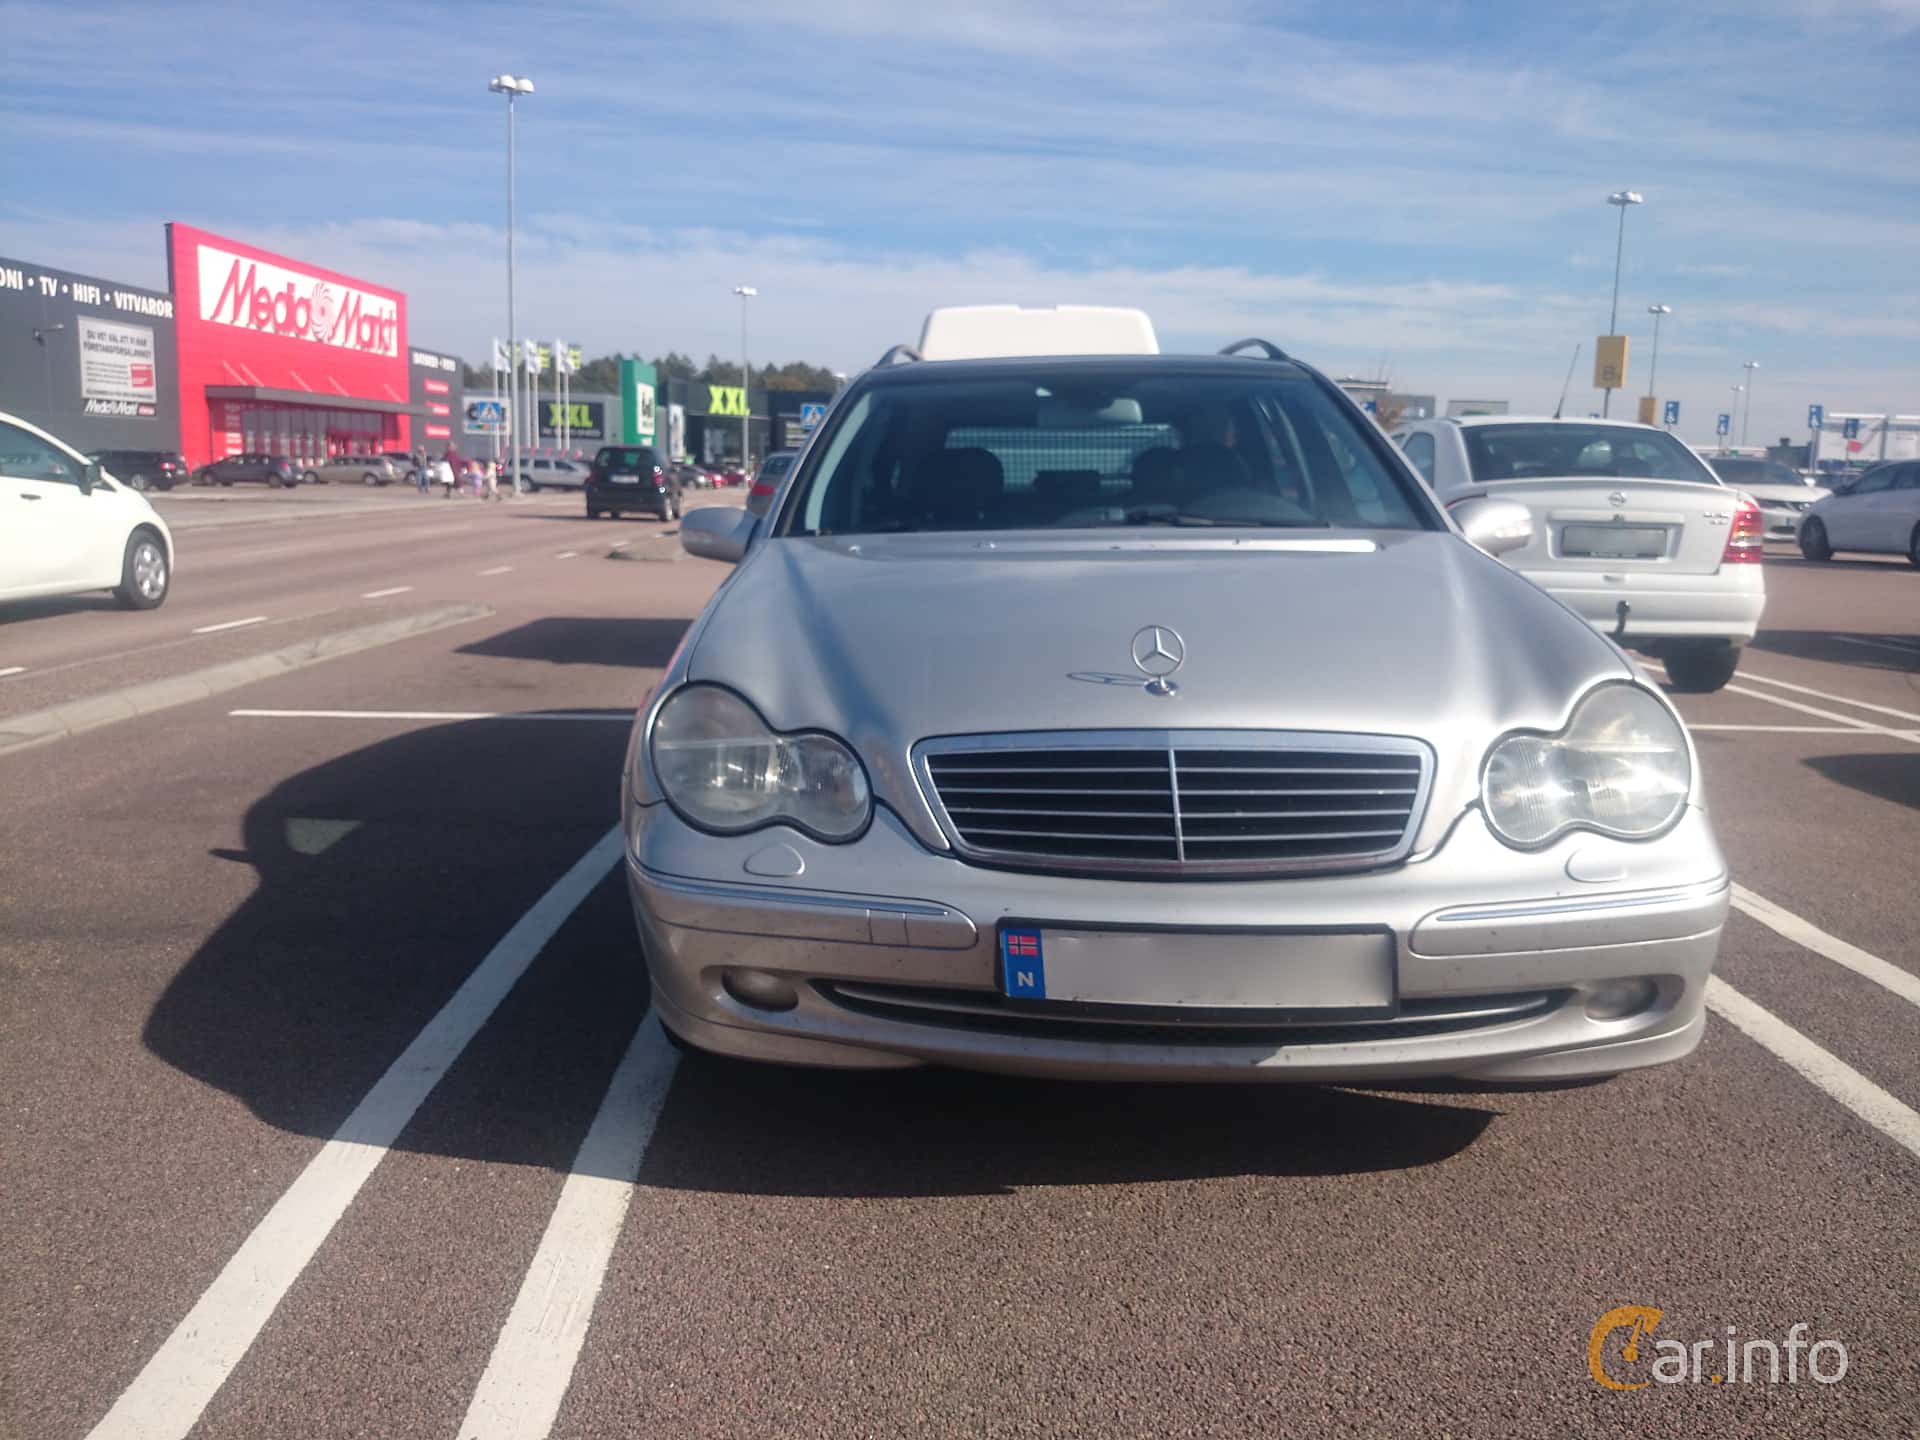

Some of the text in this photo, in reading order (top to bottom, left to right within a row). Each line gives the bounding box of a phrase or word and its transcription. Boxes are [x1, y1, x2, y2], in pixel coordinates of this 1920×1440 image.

[39, 276, 58, 297] TV
[73, 283, 101, 306] HIFI
[113, 290, 173, 319] VITVAROR
[708, 384, 751, 416] XXL
[1018, 971, 1034, 987] N
